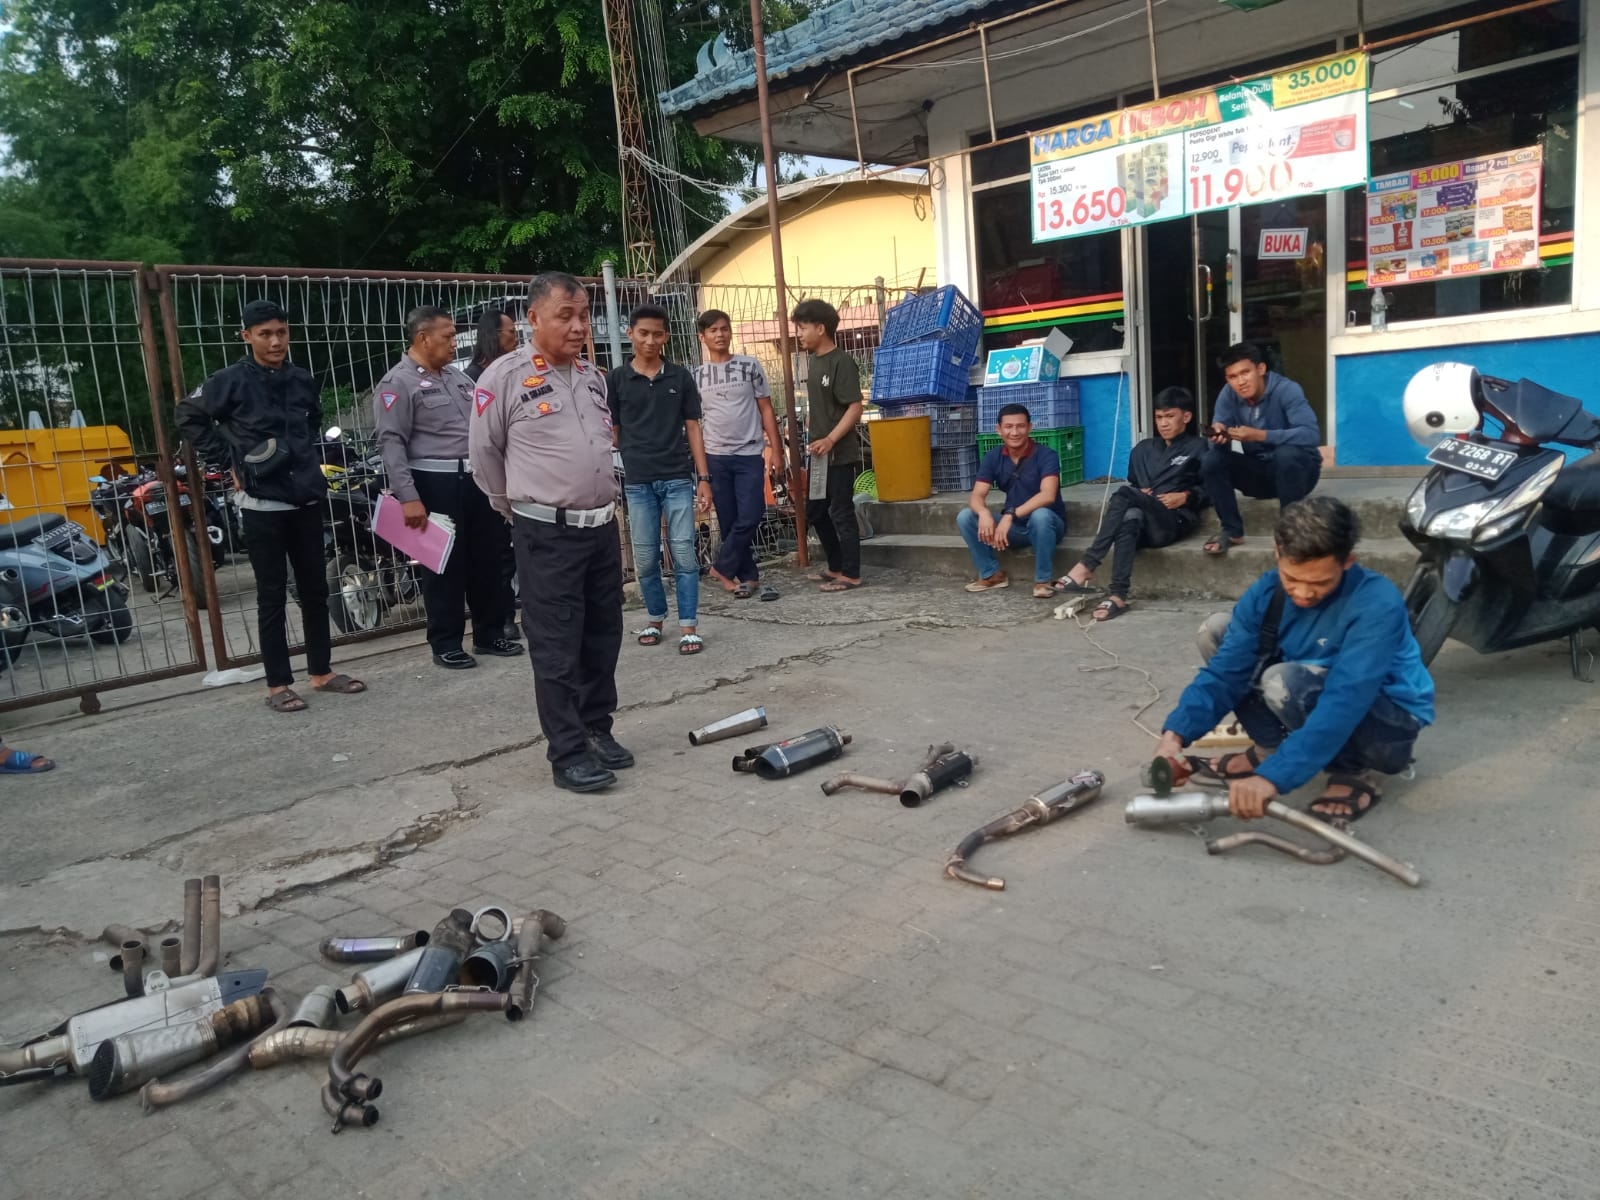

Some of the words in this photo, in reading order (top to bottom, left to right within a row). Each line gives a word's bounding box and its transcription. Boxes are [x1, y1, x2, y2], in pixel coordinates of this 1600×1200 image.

[1288, 58, 1356, 90] 35.000
[1033, 118, 1112, 156] HARGA
[1118, 95, 1207, 136] HEBOH
[1189, 126, 1221, 138] PEPSODENT
[1192, 149, 1219, 163] 12.900
[1375, 177, 1409, 190] TAMBAH
[1418, 164, 1459, 185] 5.000
[1487, 159, 1495, 172] 2
[1037, 187, 1126, 232] 13.650
[1264, 234, 1301, 253] BUKA
[1458, 445, 1492, 460] 2268
[1491, 453, 1513, 465] RT
